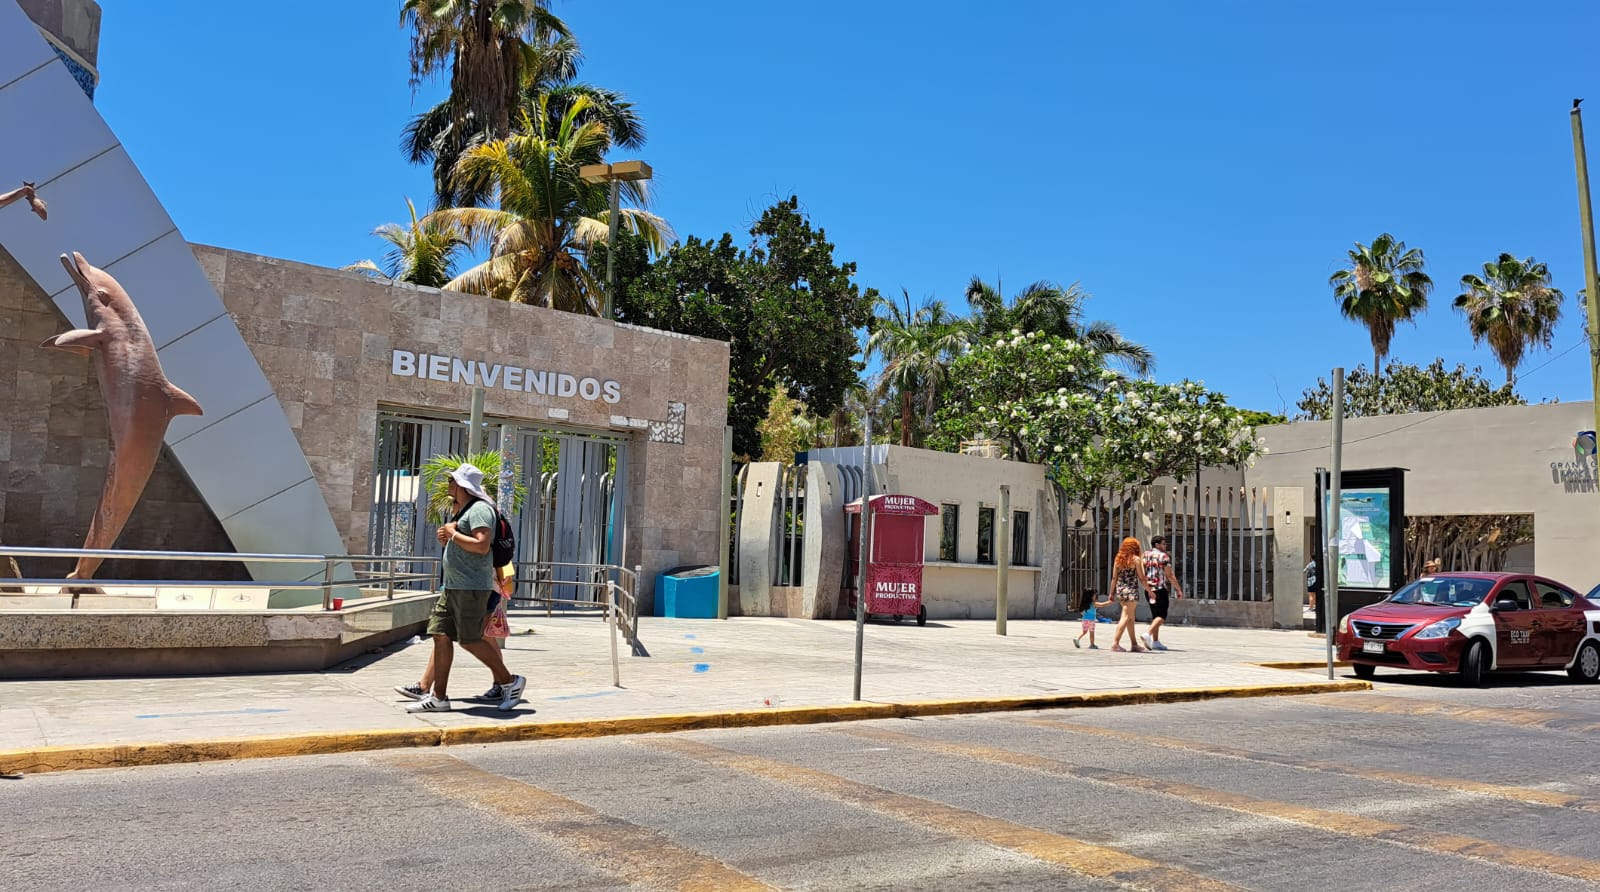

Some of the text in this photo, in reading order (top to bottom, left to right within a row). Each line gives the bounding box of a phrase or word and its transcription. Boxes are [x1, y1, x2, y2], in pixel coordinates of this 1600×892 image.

[392, 350, 621, 404] BIENVENIDOS
[885, 496, 915, 505] MUJER
[876, 582, 916, 593] MUJER
[875, 592, 916, 600] PRODUCTIVA
